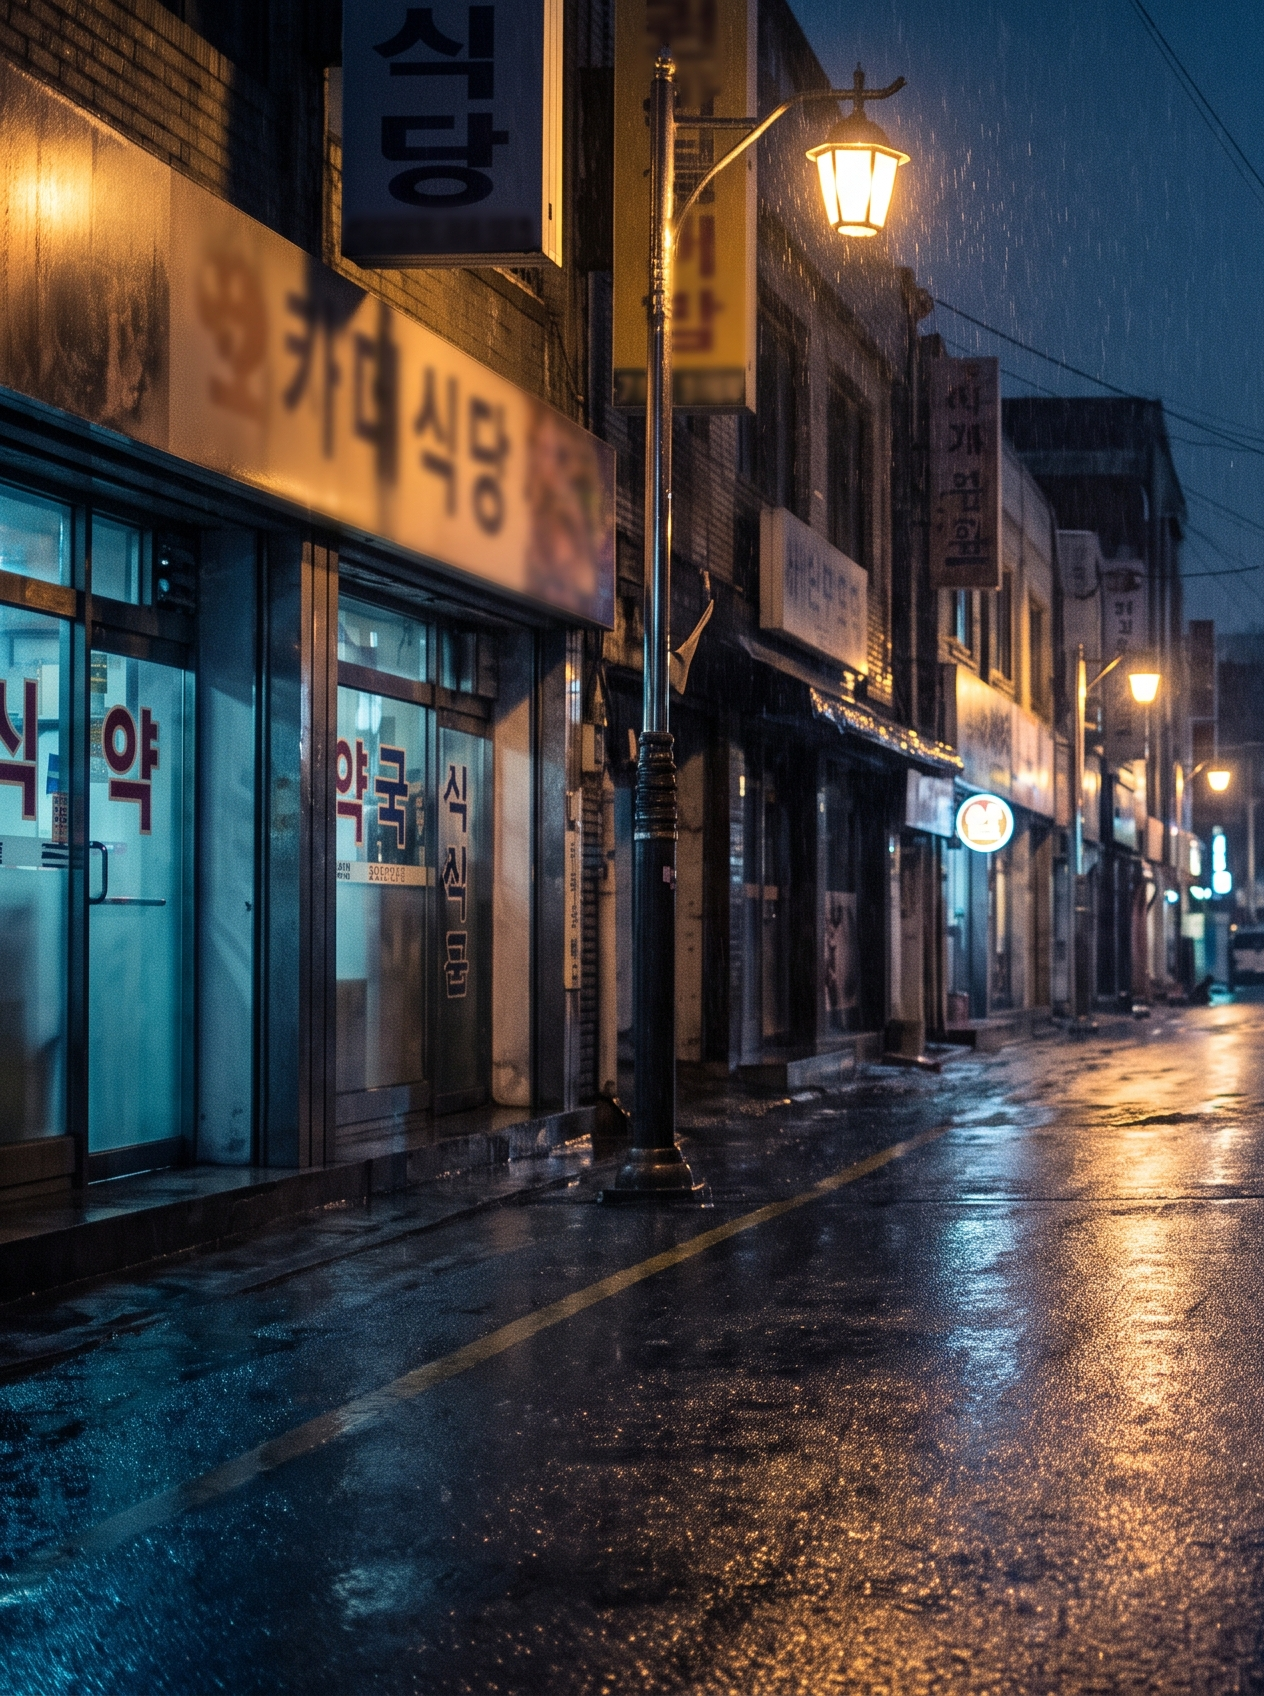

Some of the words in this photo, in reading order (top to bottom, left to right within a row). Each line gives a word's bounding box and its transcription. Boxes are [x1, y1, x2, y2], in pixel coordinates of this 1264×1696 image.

[372, 5, 509, 208] 식당
[102, 703, 160, 835] 약
[336, 738, 409, 850] 약국
